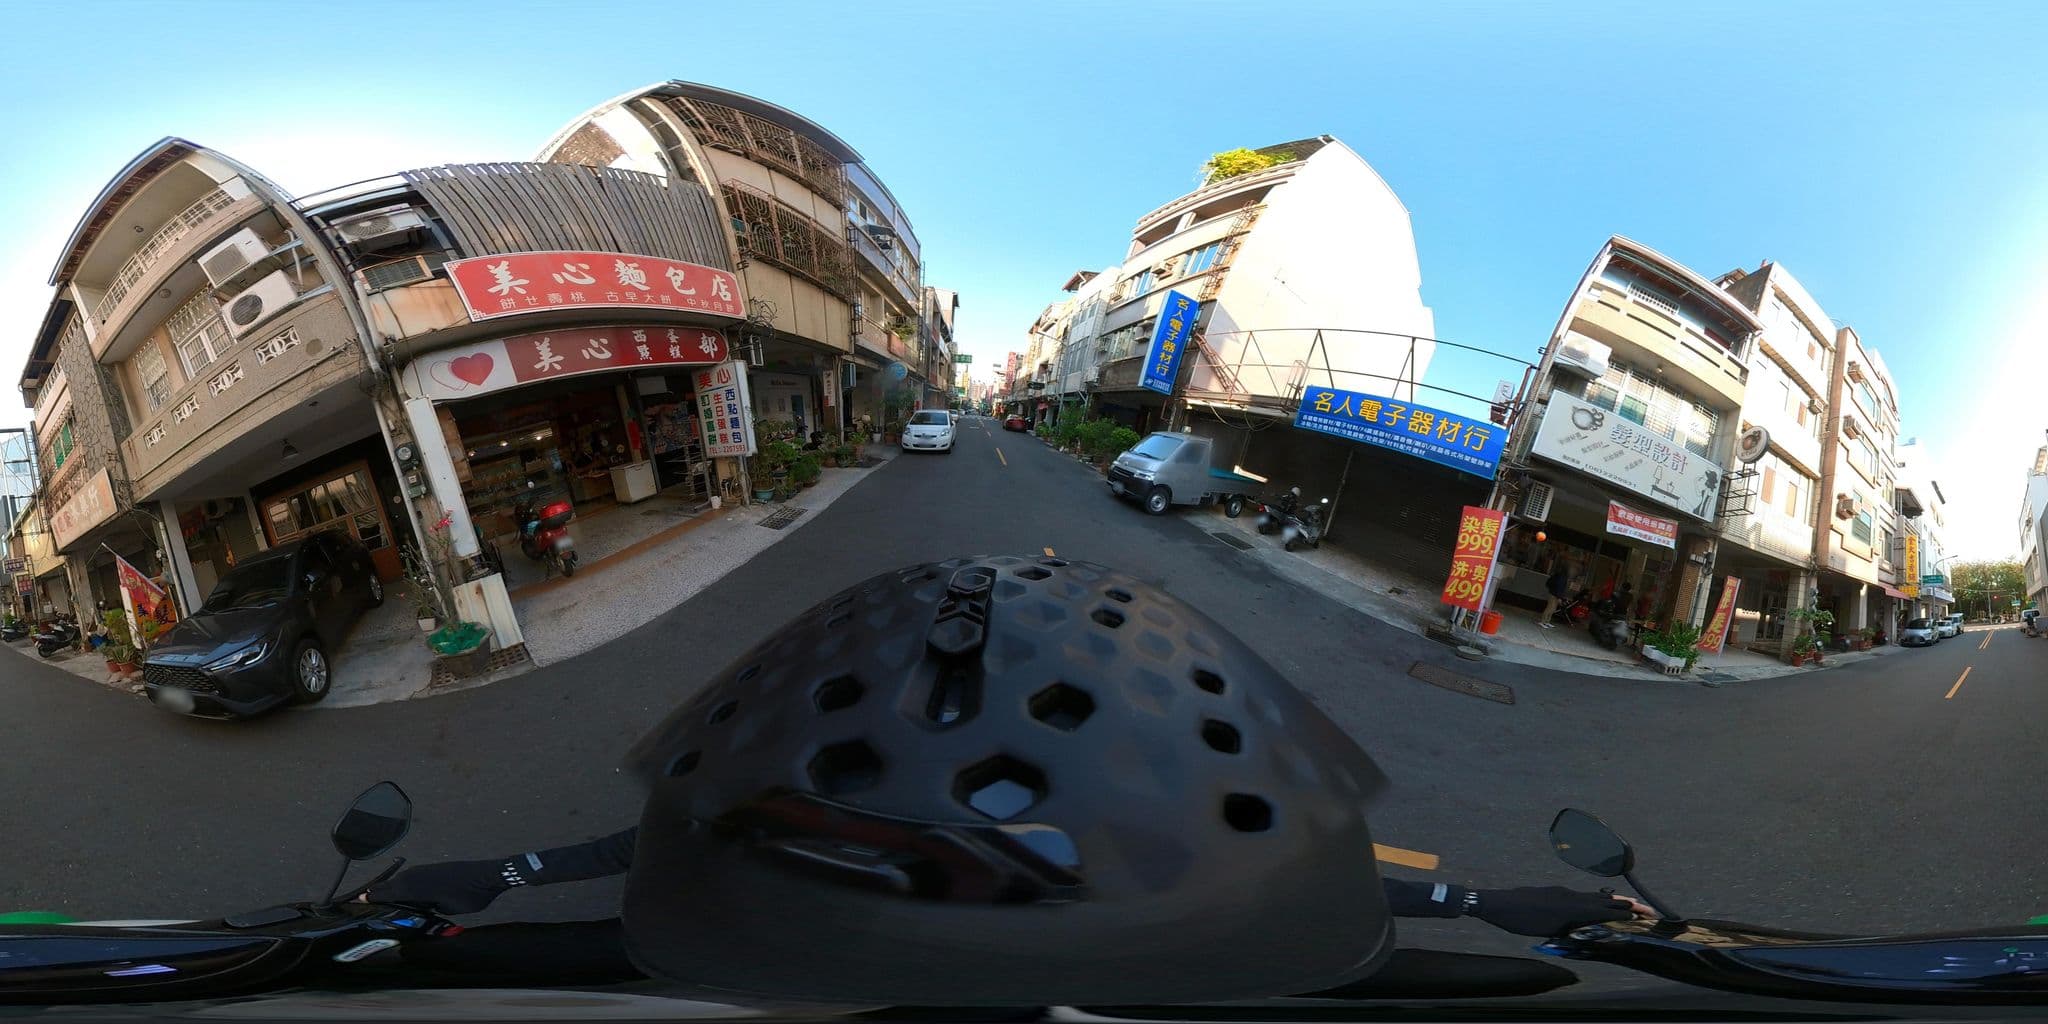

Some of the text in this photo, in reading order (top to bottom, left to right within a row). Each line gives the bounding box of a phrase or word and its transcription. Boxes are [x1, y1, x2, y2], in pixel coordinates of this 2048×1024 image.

[486, 258, 732, 302] 美心麵包店
[1155, 298, 1190, 377] 名人電子器材行
[698, 367, 732, 390] 美心
[1313, 391, 1491, 452] 名人電子器材行
[1610, 423, 1689, 476] 髮型設計
[1457, 532, 1493, 554] 999
[1461, 515, 1500, 537] 染髮
[1445, 578, 1483, 602] 499
